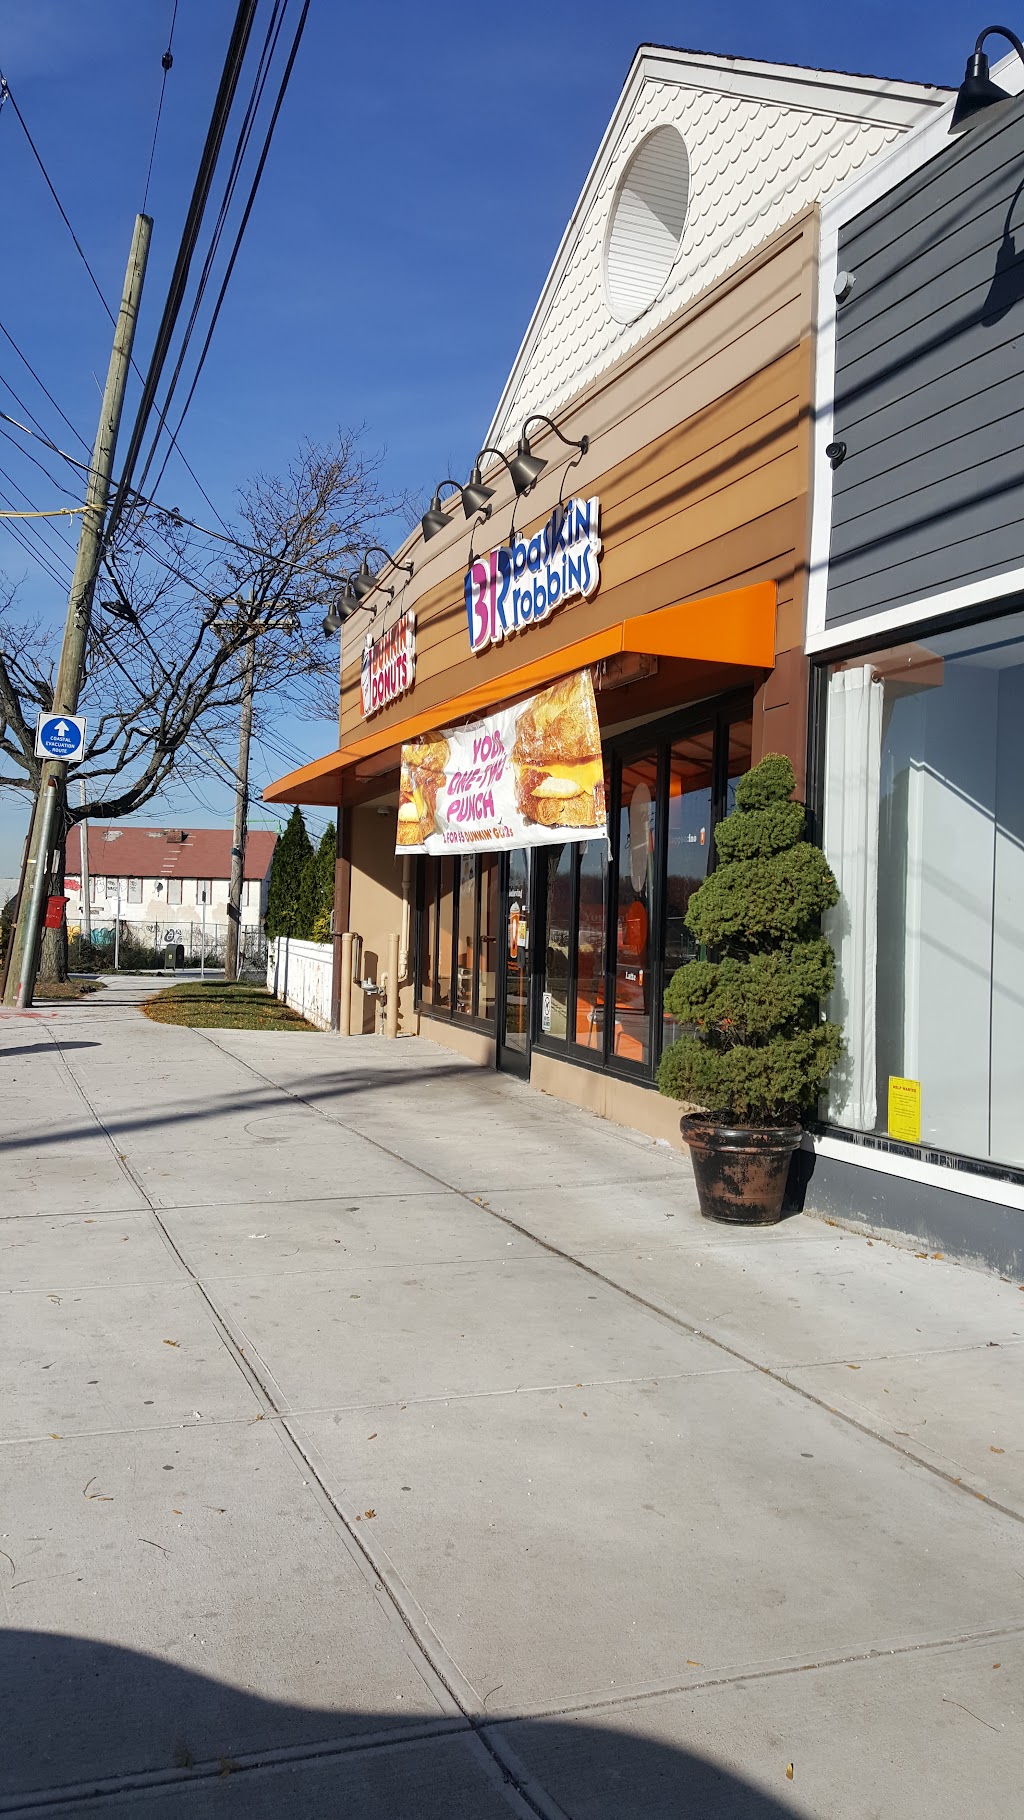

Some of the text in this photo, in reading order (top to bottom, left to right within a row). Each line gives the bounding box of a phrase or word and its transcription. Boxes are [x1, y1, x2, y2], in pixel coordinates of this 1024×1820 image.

[372, 653, 407, 707] DONUTS
[45, 741, 75, 749] EVACUATION
[50, 735, 72, 743] COASTAL
[447, 789, 495, 823] PUNCH
[447, 831, 457, 844] FOR
